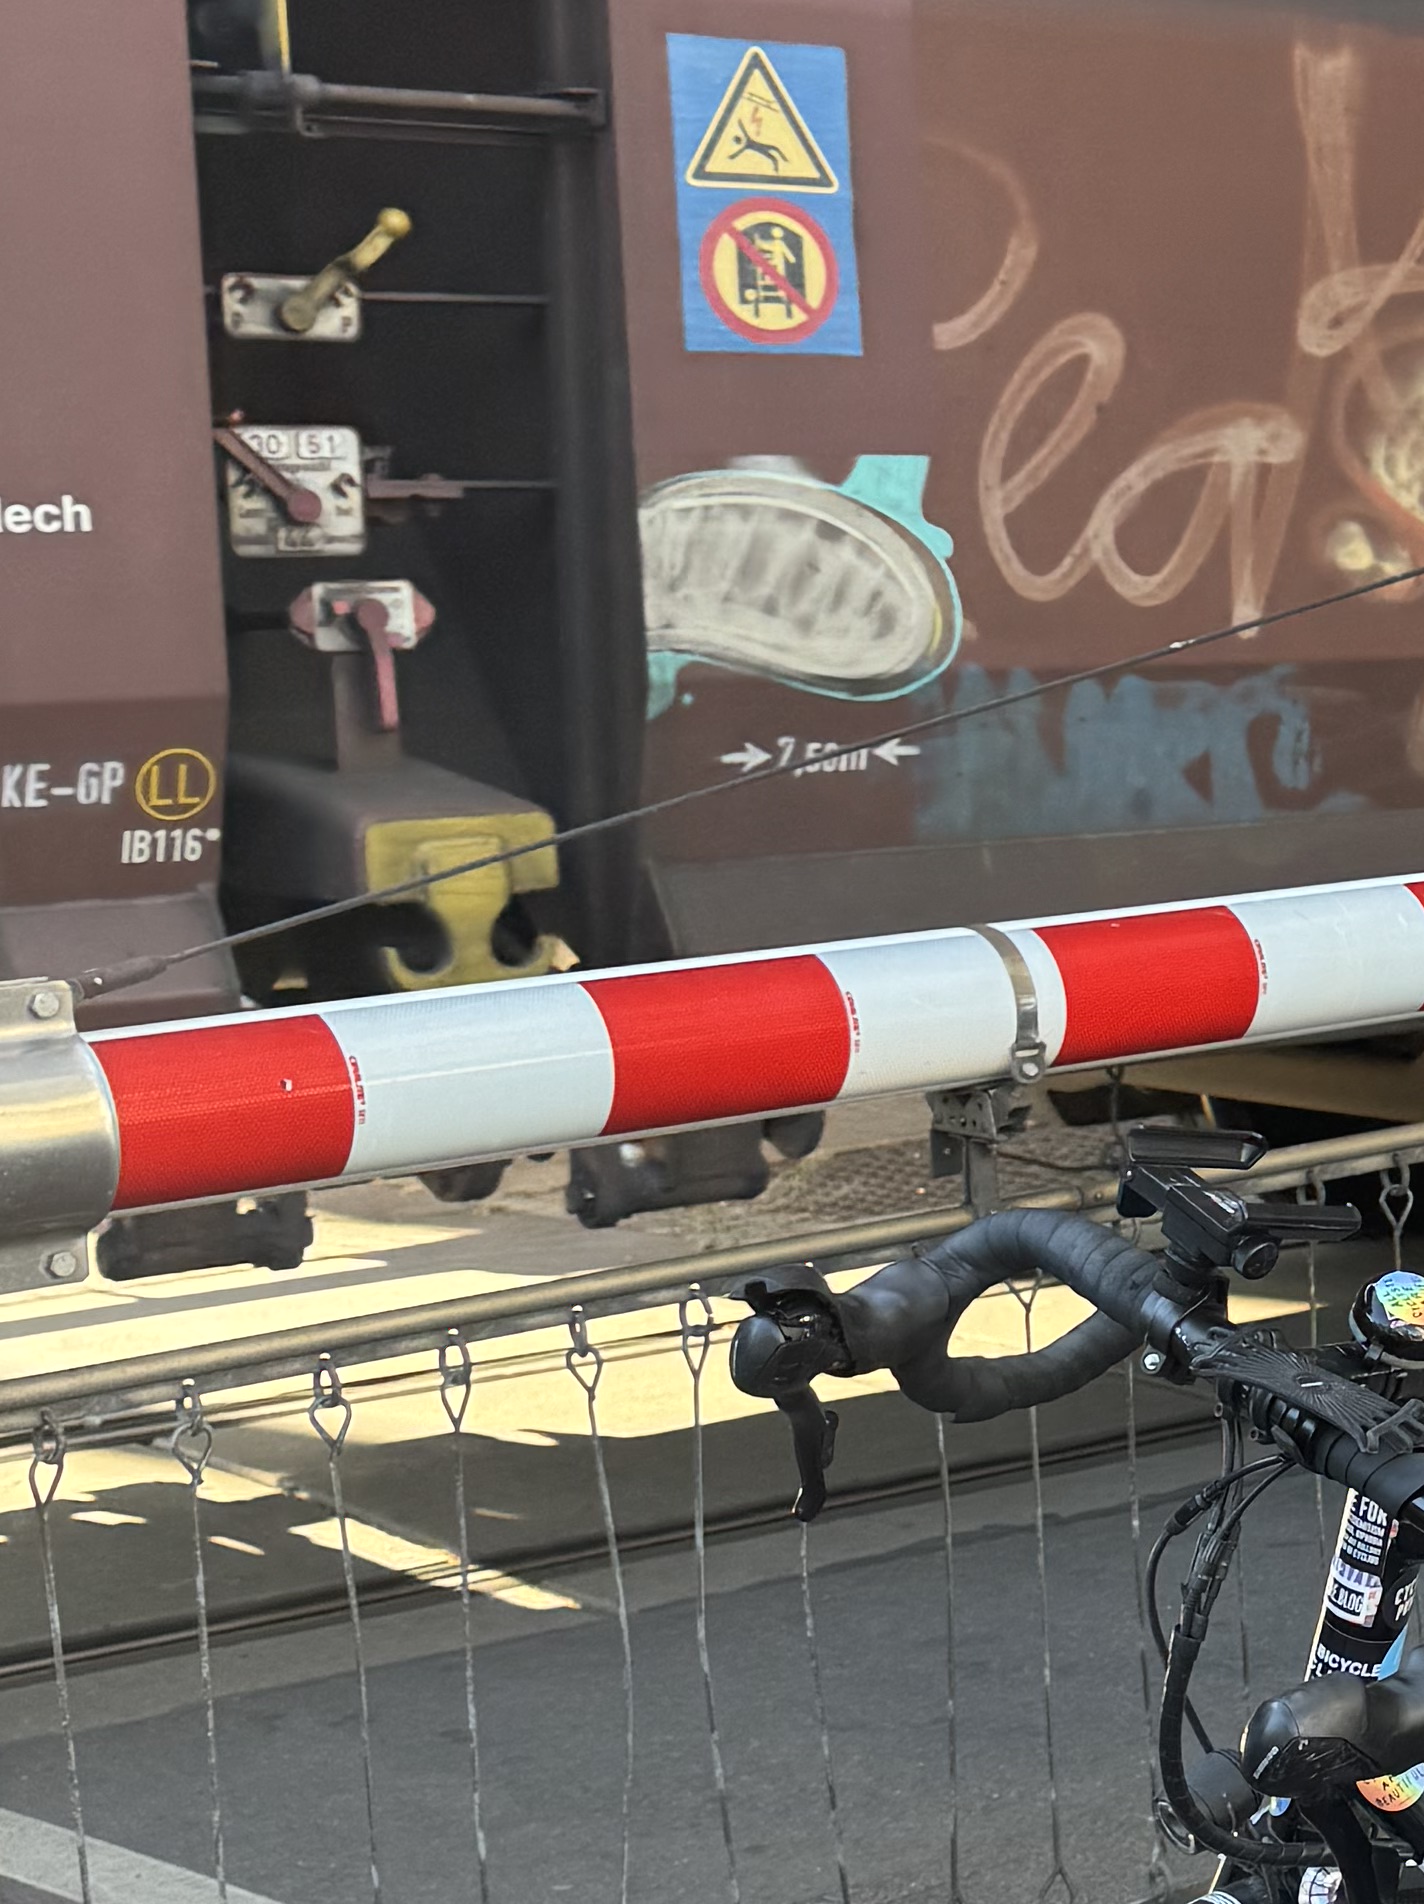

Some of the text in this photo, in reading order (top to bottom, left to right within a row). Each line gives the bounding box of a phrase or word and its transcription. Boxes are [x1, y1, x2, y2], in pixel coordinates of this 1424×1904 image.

[0, 493, 94, 533] ech
[147, 764, 201, 807] LL
[1315, 1643, 1382, 1679] BICYCLE
